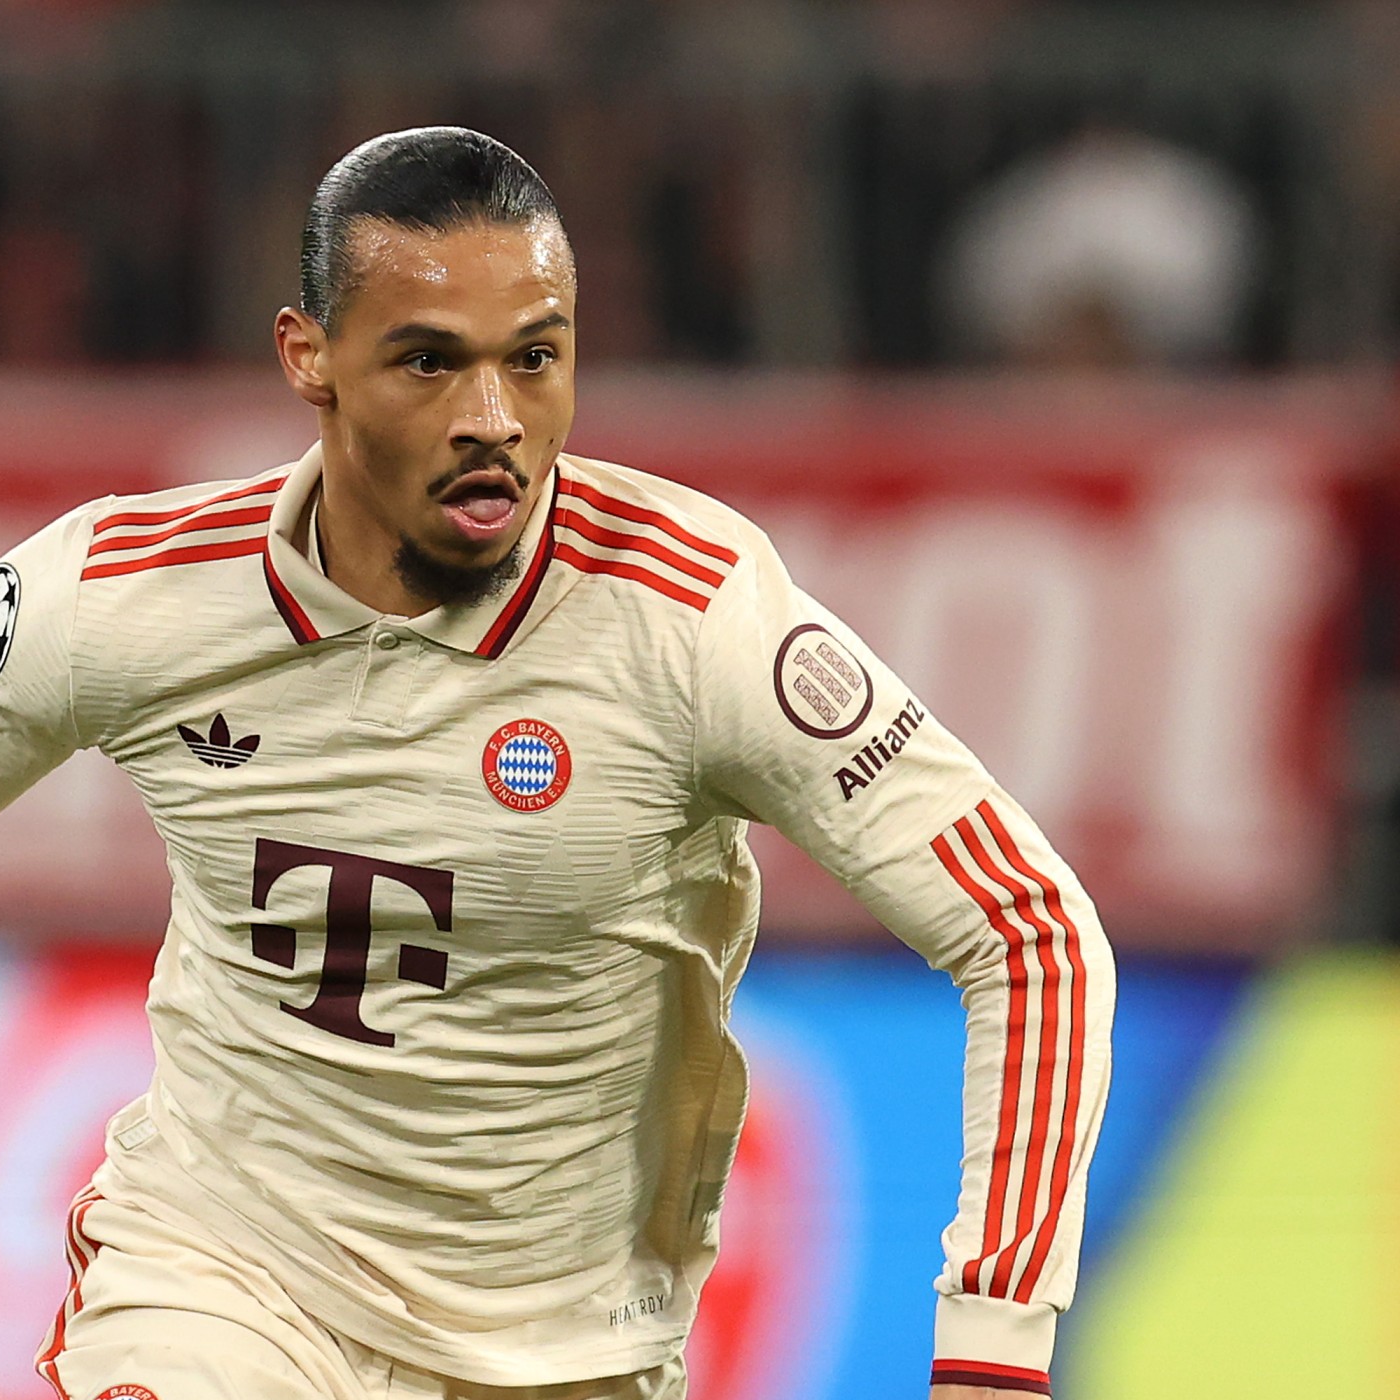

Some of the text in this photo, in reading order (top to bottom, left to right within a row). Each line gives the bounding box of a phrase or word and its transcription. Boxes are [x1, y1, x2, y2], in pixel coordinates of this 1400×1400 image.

[518, 722, 565, 756] BAYERN
[832, 697, 925, 802] Allianz
[486, 770, 546, 808] MÜNCHEN
[250, 837, 455, 1048] T
